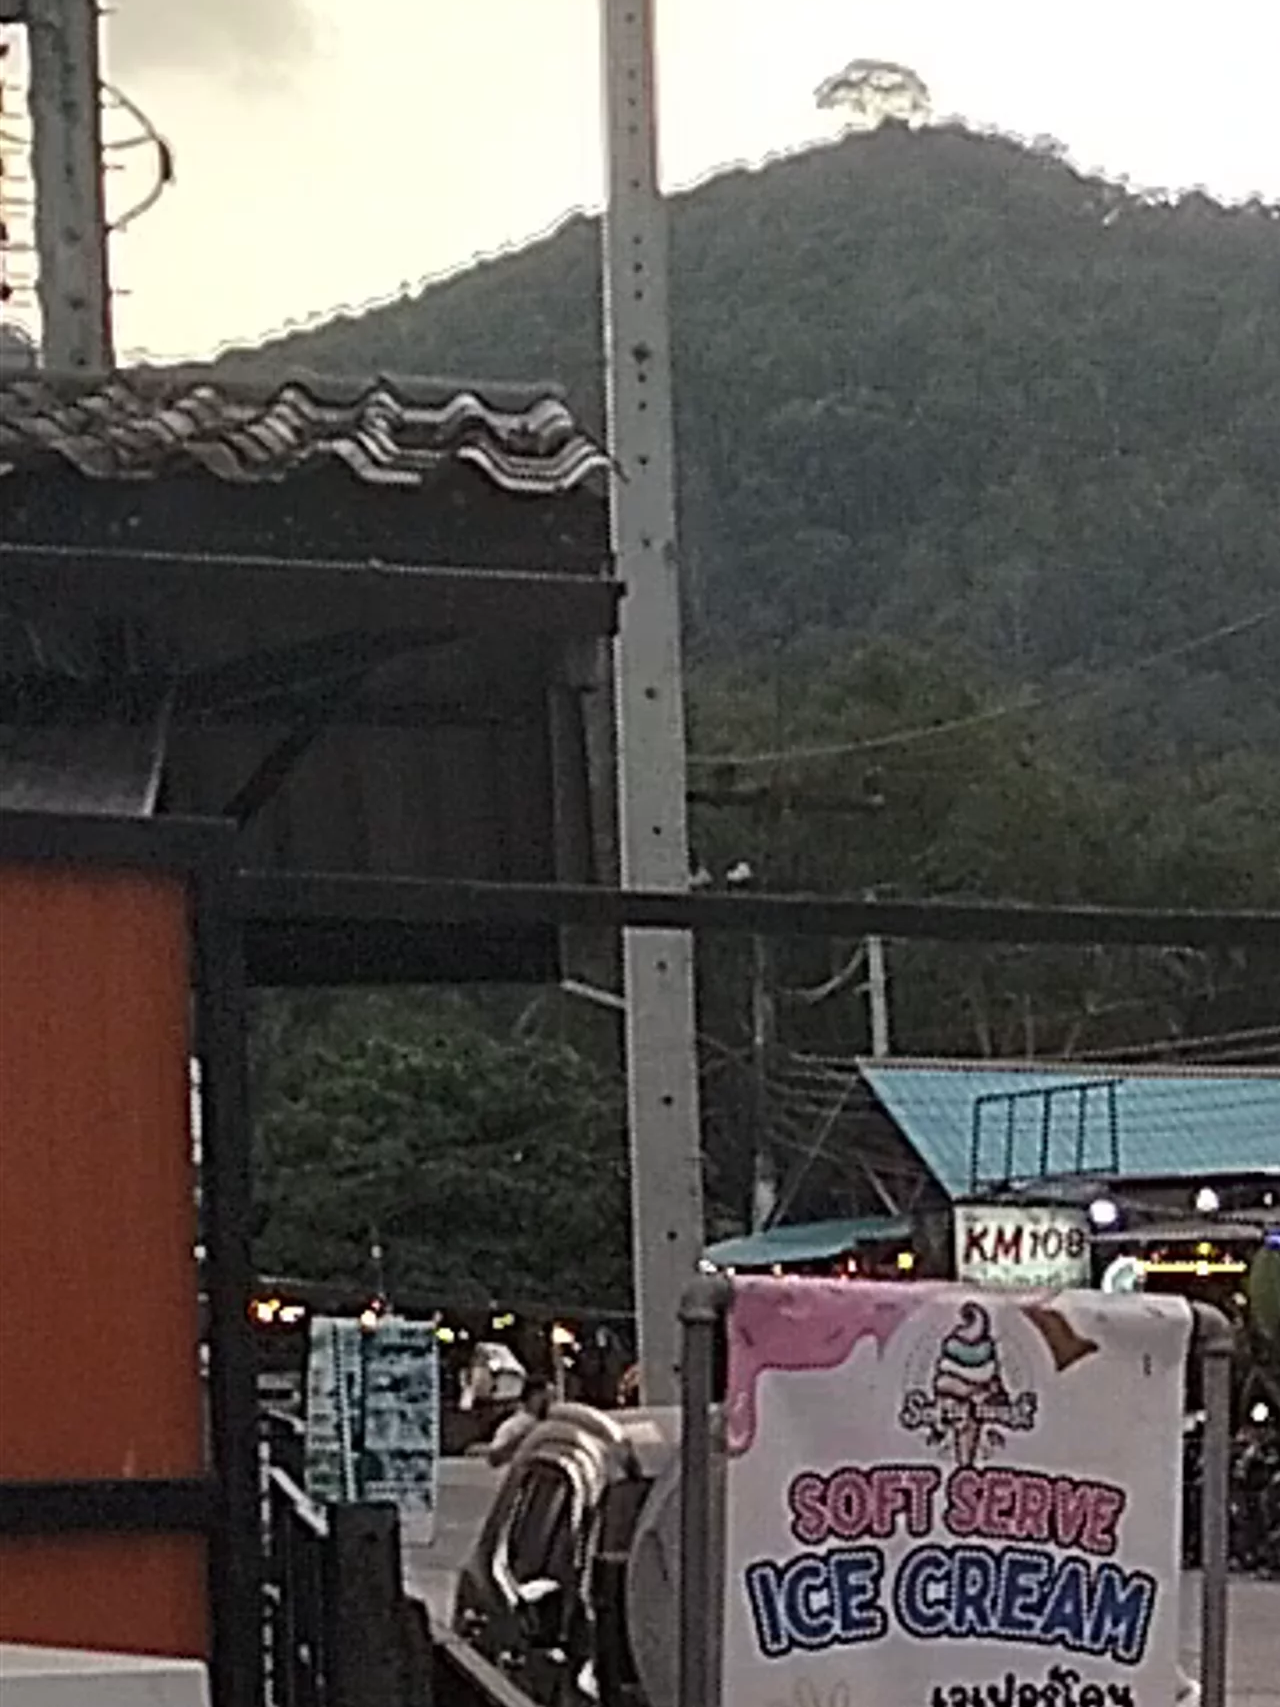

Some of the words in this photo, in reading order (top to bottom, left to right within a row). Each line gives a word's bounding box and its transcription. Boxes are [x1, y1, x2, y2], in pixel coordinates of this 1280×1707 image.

[788, 1465, 940, 1546] SOFT
[942, 1466, 1127, 1556] SERVE
[746, 1545, 889, 1659] ICE
[894, 1543, 1157, 1665] CREAM
